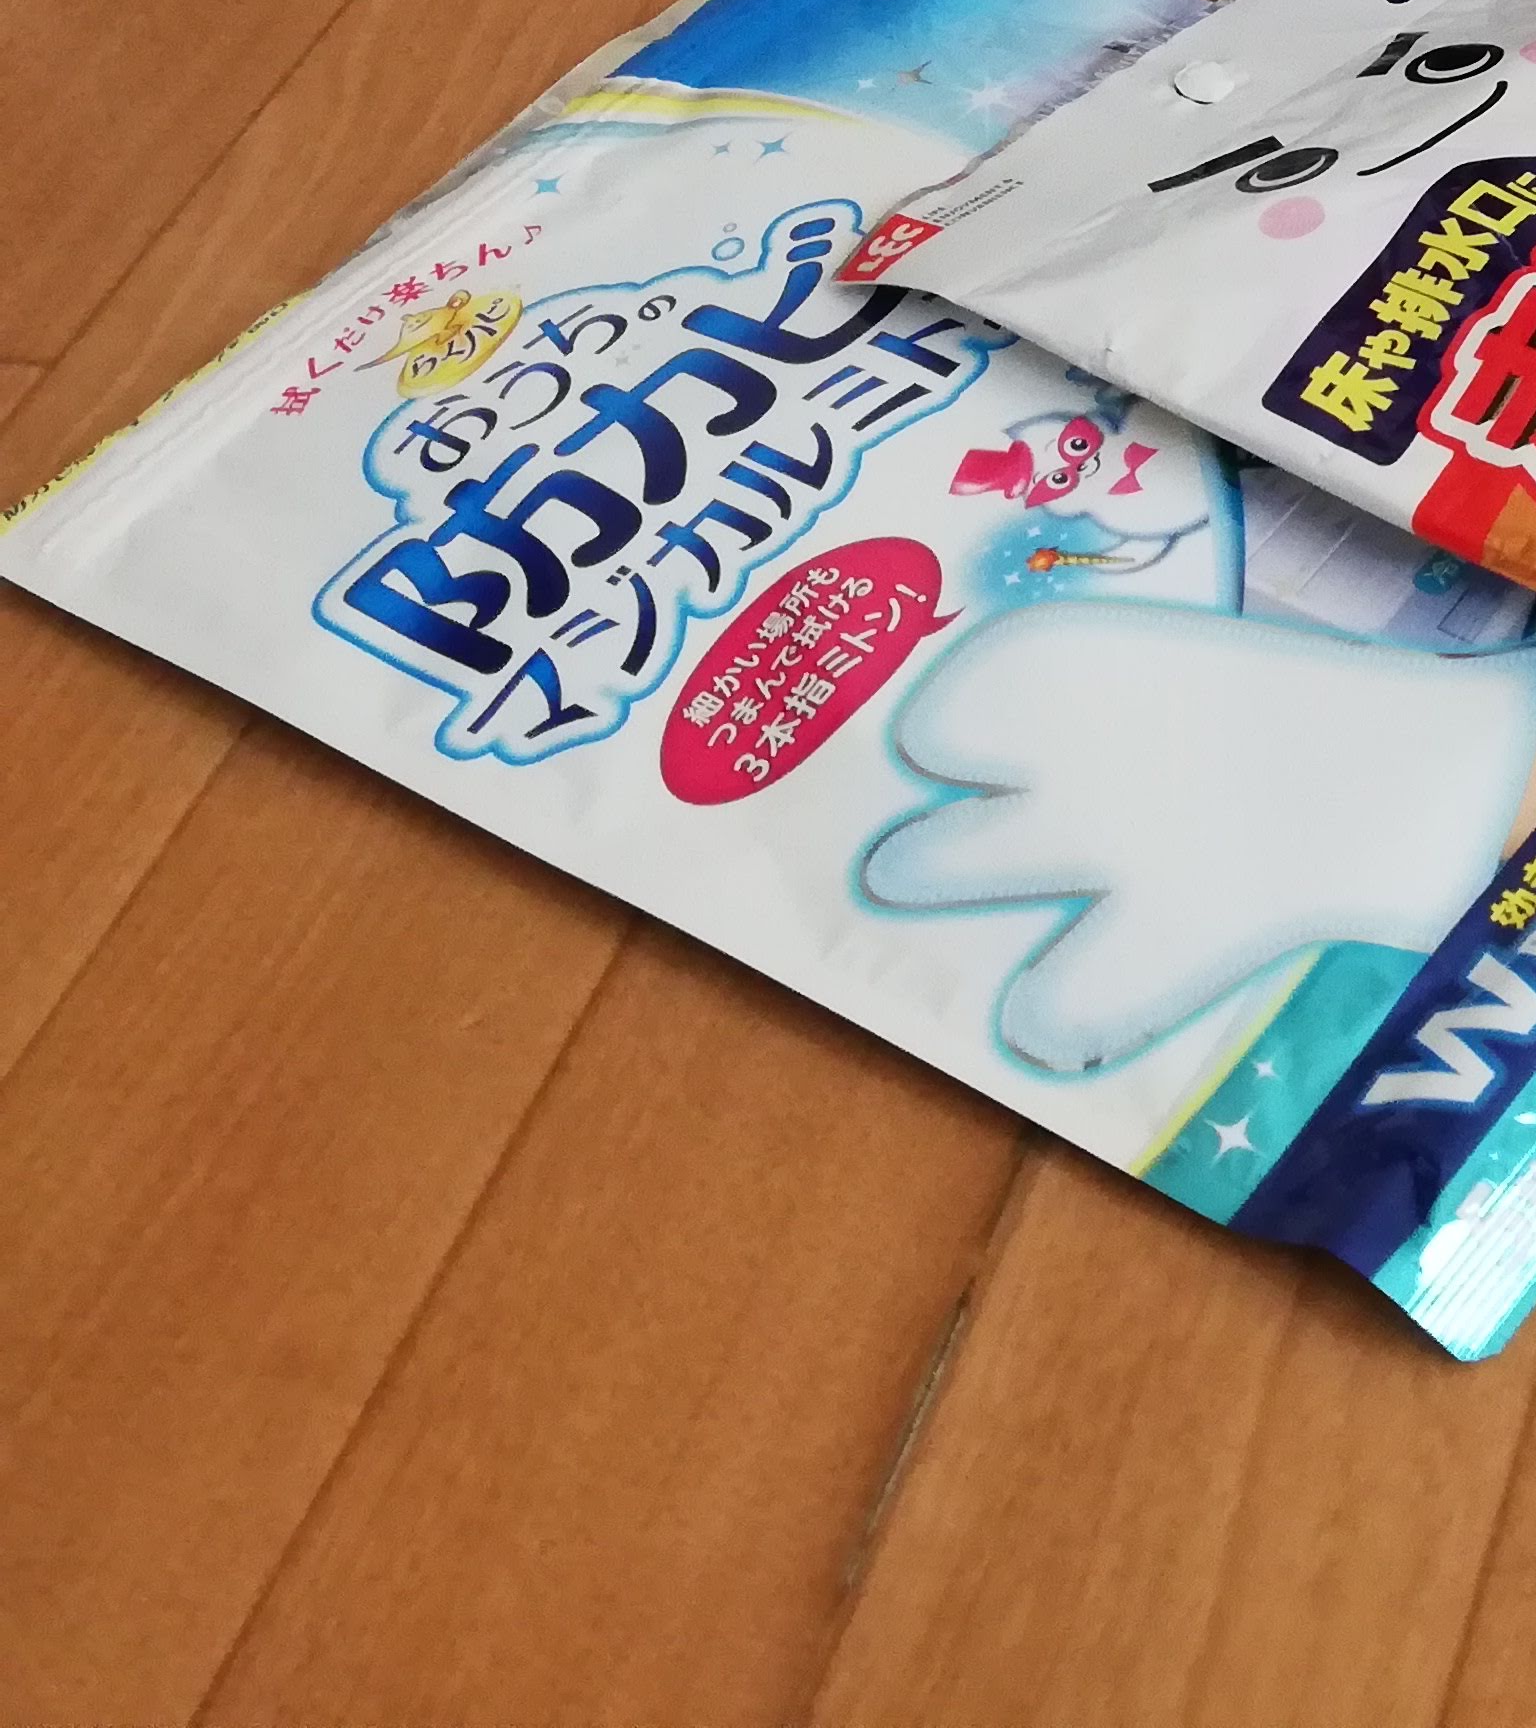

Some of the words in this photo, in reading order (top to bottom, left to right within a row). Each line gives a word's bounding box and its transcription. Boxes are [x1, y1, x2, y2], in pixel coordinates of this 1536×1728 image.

[342, 217, 903, 673] 防カビ
[394, 294, 676, 472] おうちの
[683, 567, 840, 728] 細かい場所も
[708, 576, 874, 747] つまんで拭ける
[733, 583, 927, 782] 3本指ミトン!
